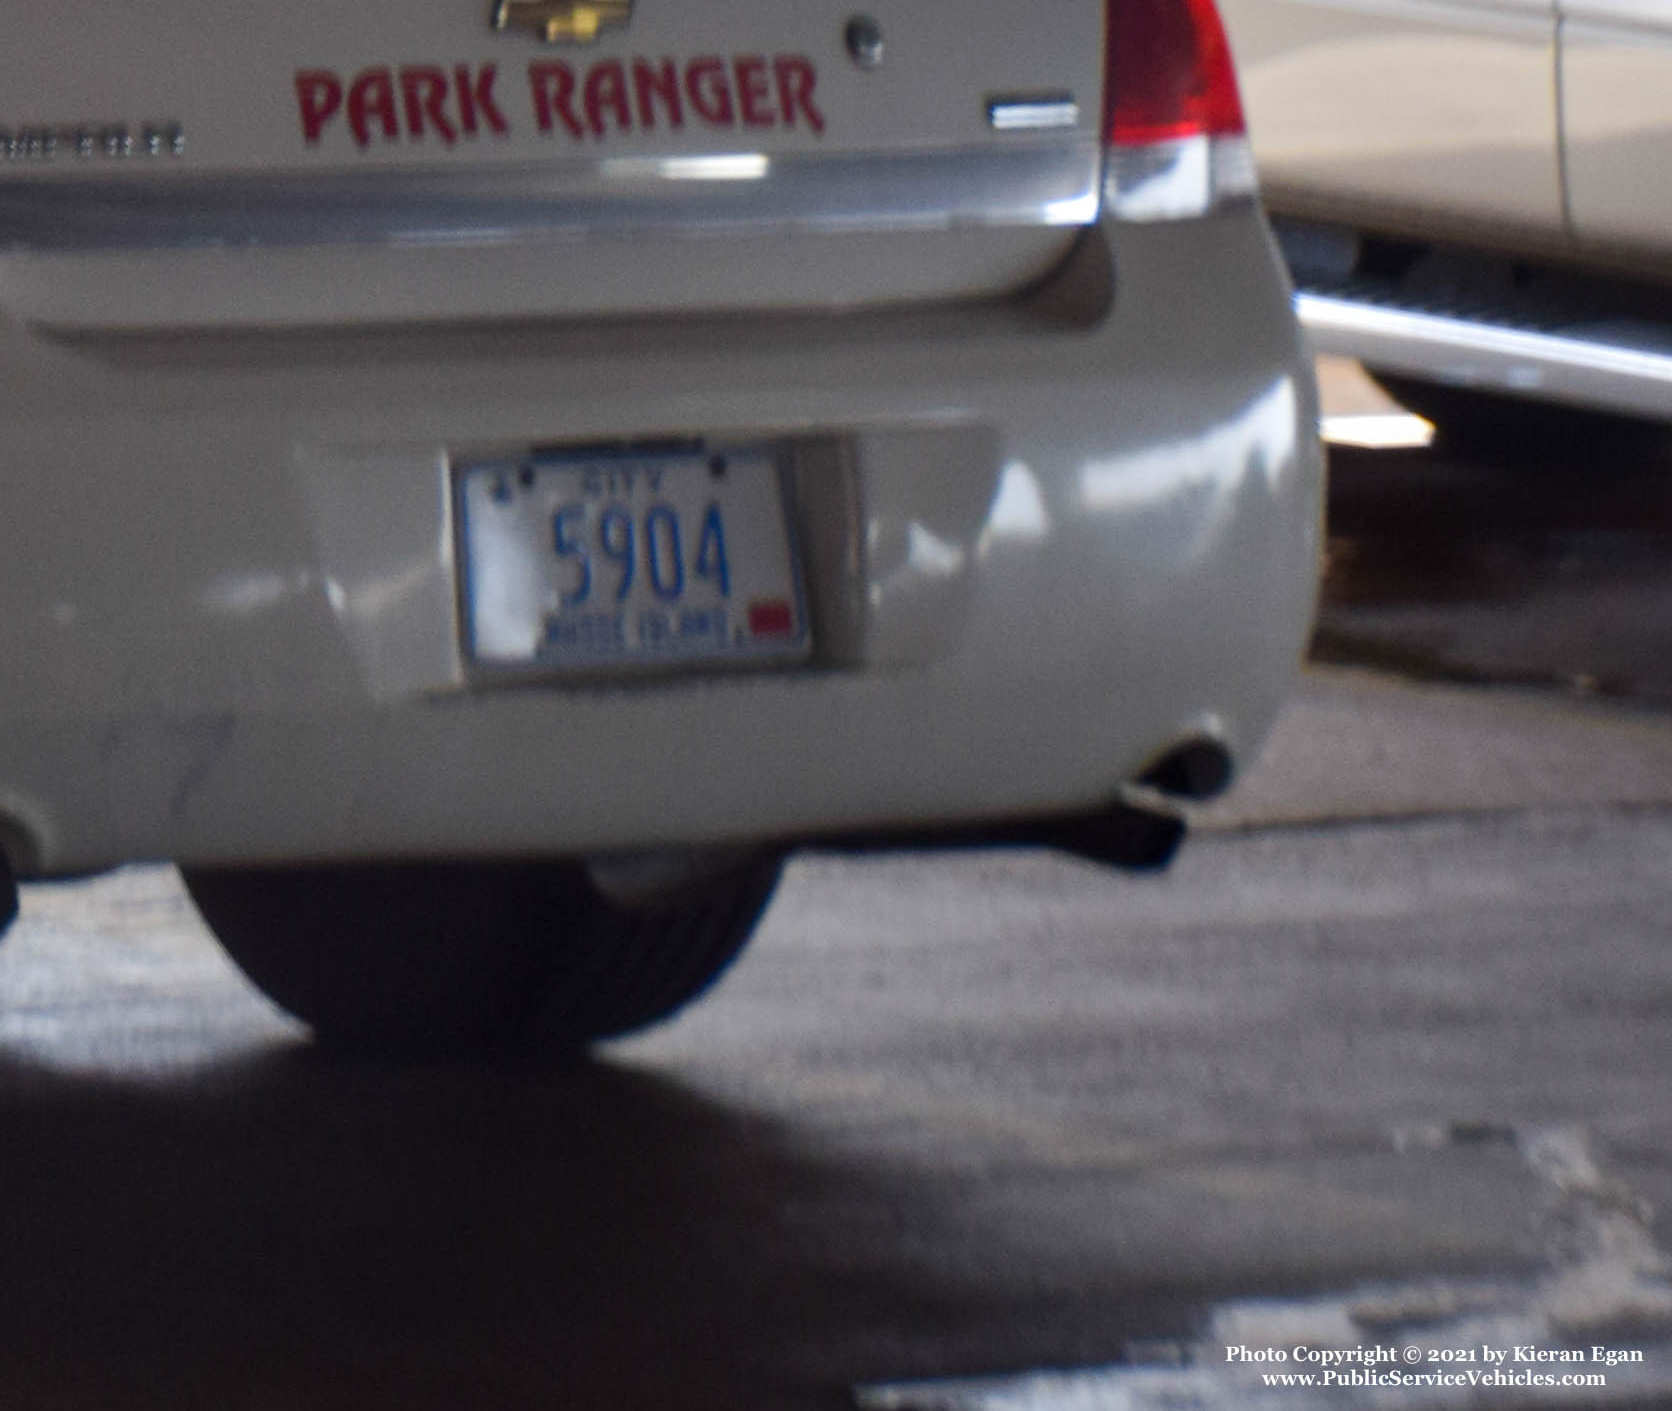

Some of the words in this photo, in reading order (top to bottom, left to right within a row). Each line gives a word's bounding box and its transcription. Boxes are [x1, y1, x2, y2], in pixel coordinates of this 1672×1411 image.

[295, 63, 508, 147] PARK
[529, 55, 825, 140] RANGER
[552, 500, 731, 605] 5904
